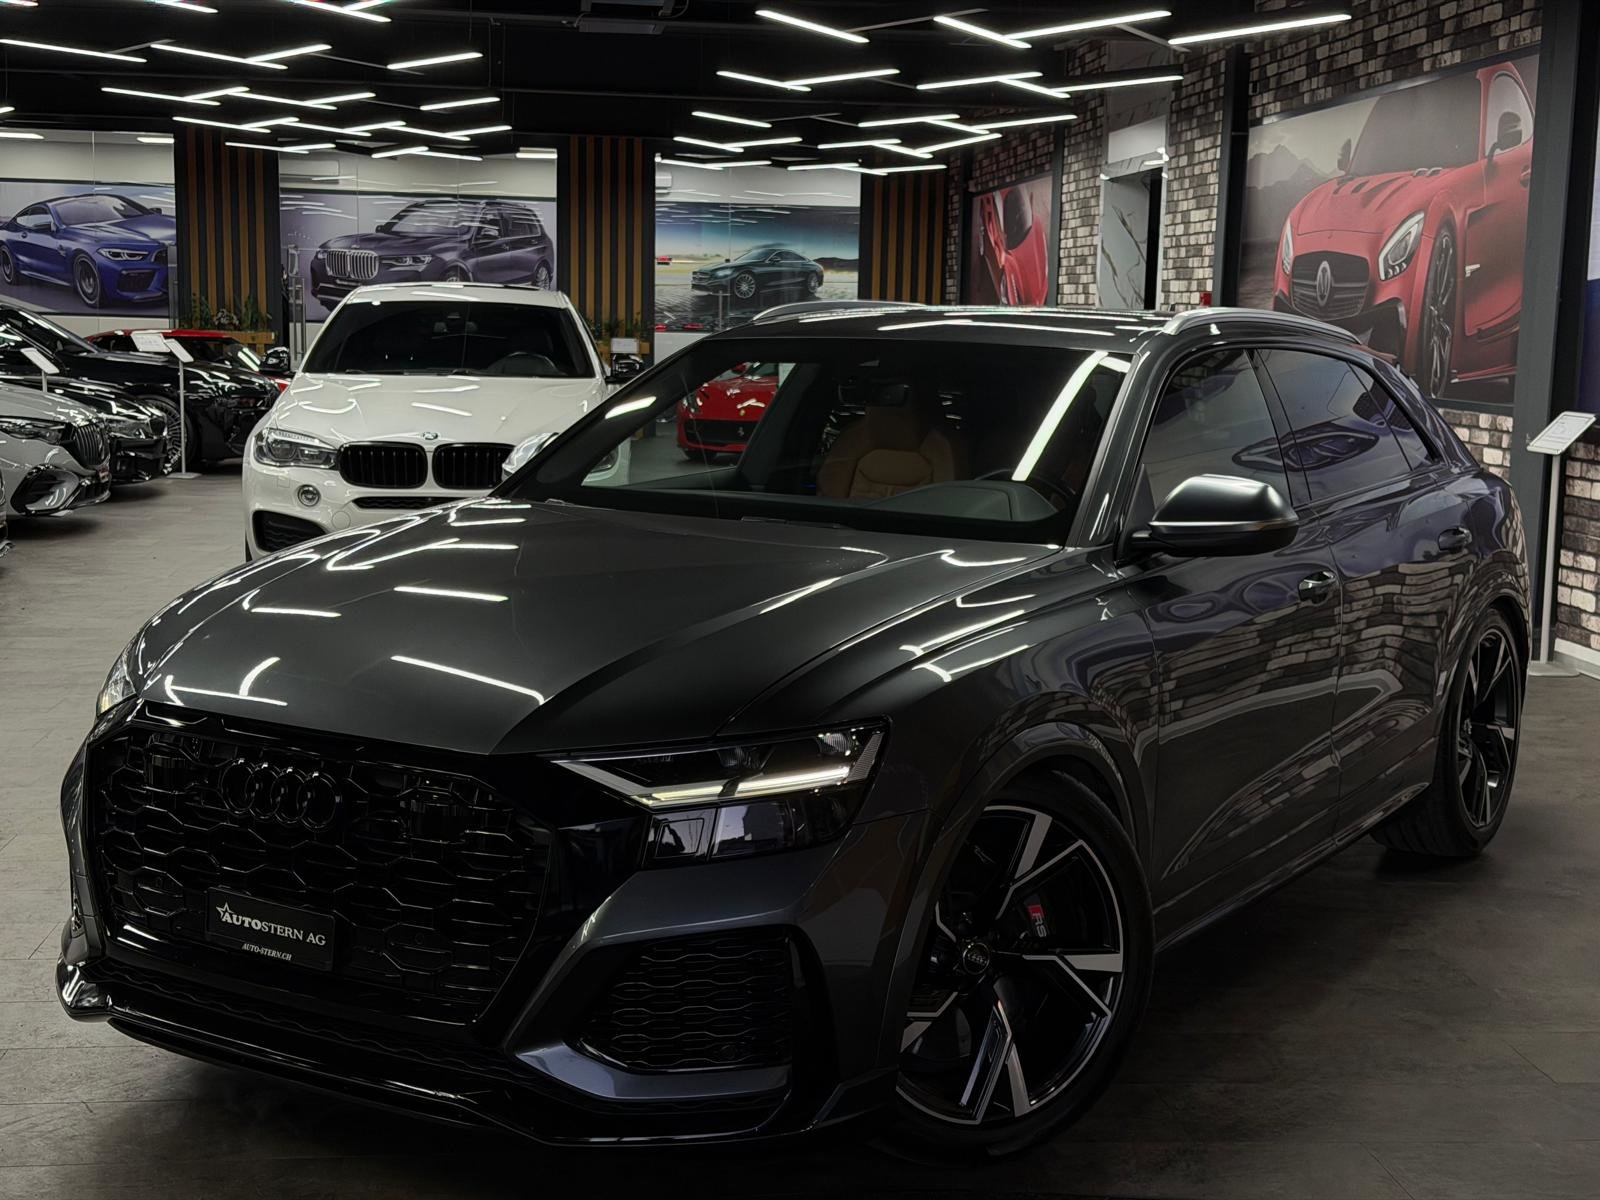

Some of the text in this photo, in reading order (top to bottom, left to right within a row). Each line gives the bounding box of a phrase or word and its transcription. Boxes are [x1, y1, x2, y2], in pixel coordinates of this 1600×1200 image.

[221, 912, 327, 946] AUTOSTERN AG
[241, 942, 292, 961] AUTO-STERN.CH
